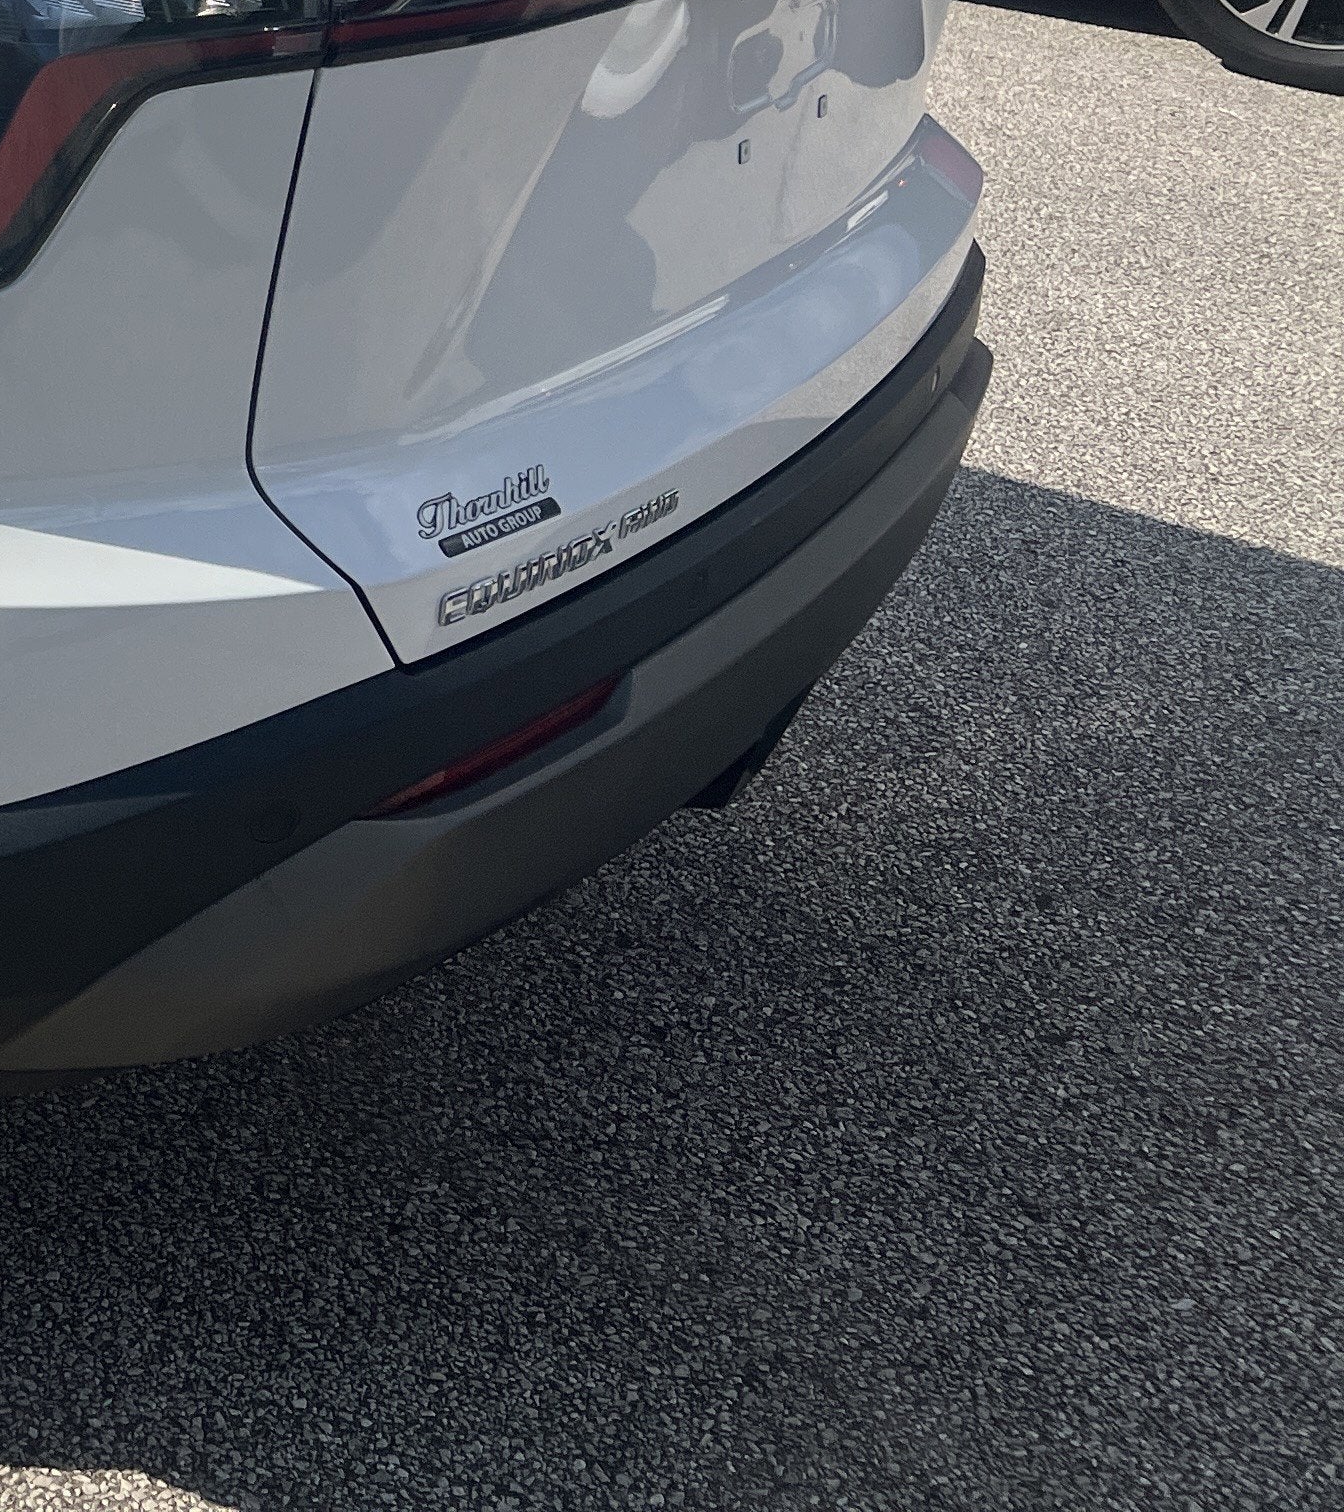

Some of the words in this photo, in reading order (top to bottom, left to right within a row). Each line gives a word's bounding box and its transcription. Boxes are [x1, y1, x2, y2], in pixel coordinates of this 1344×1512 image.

[417, 464, 550, 540] Thornhill
[462, 523, 499, 549] AUTO
[500, 505, 544, 535] GROUP
[437, 519, 617, 626] EQUINOX
